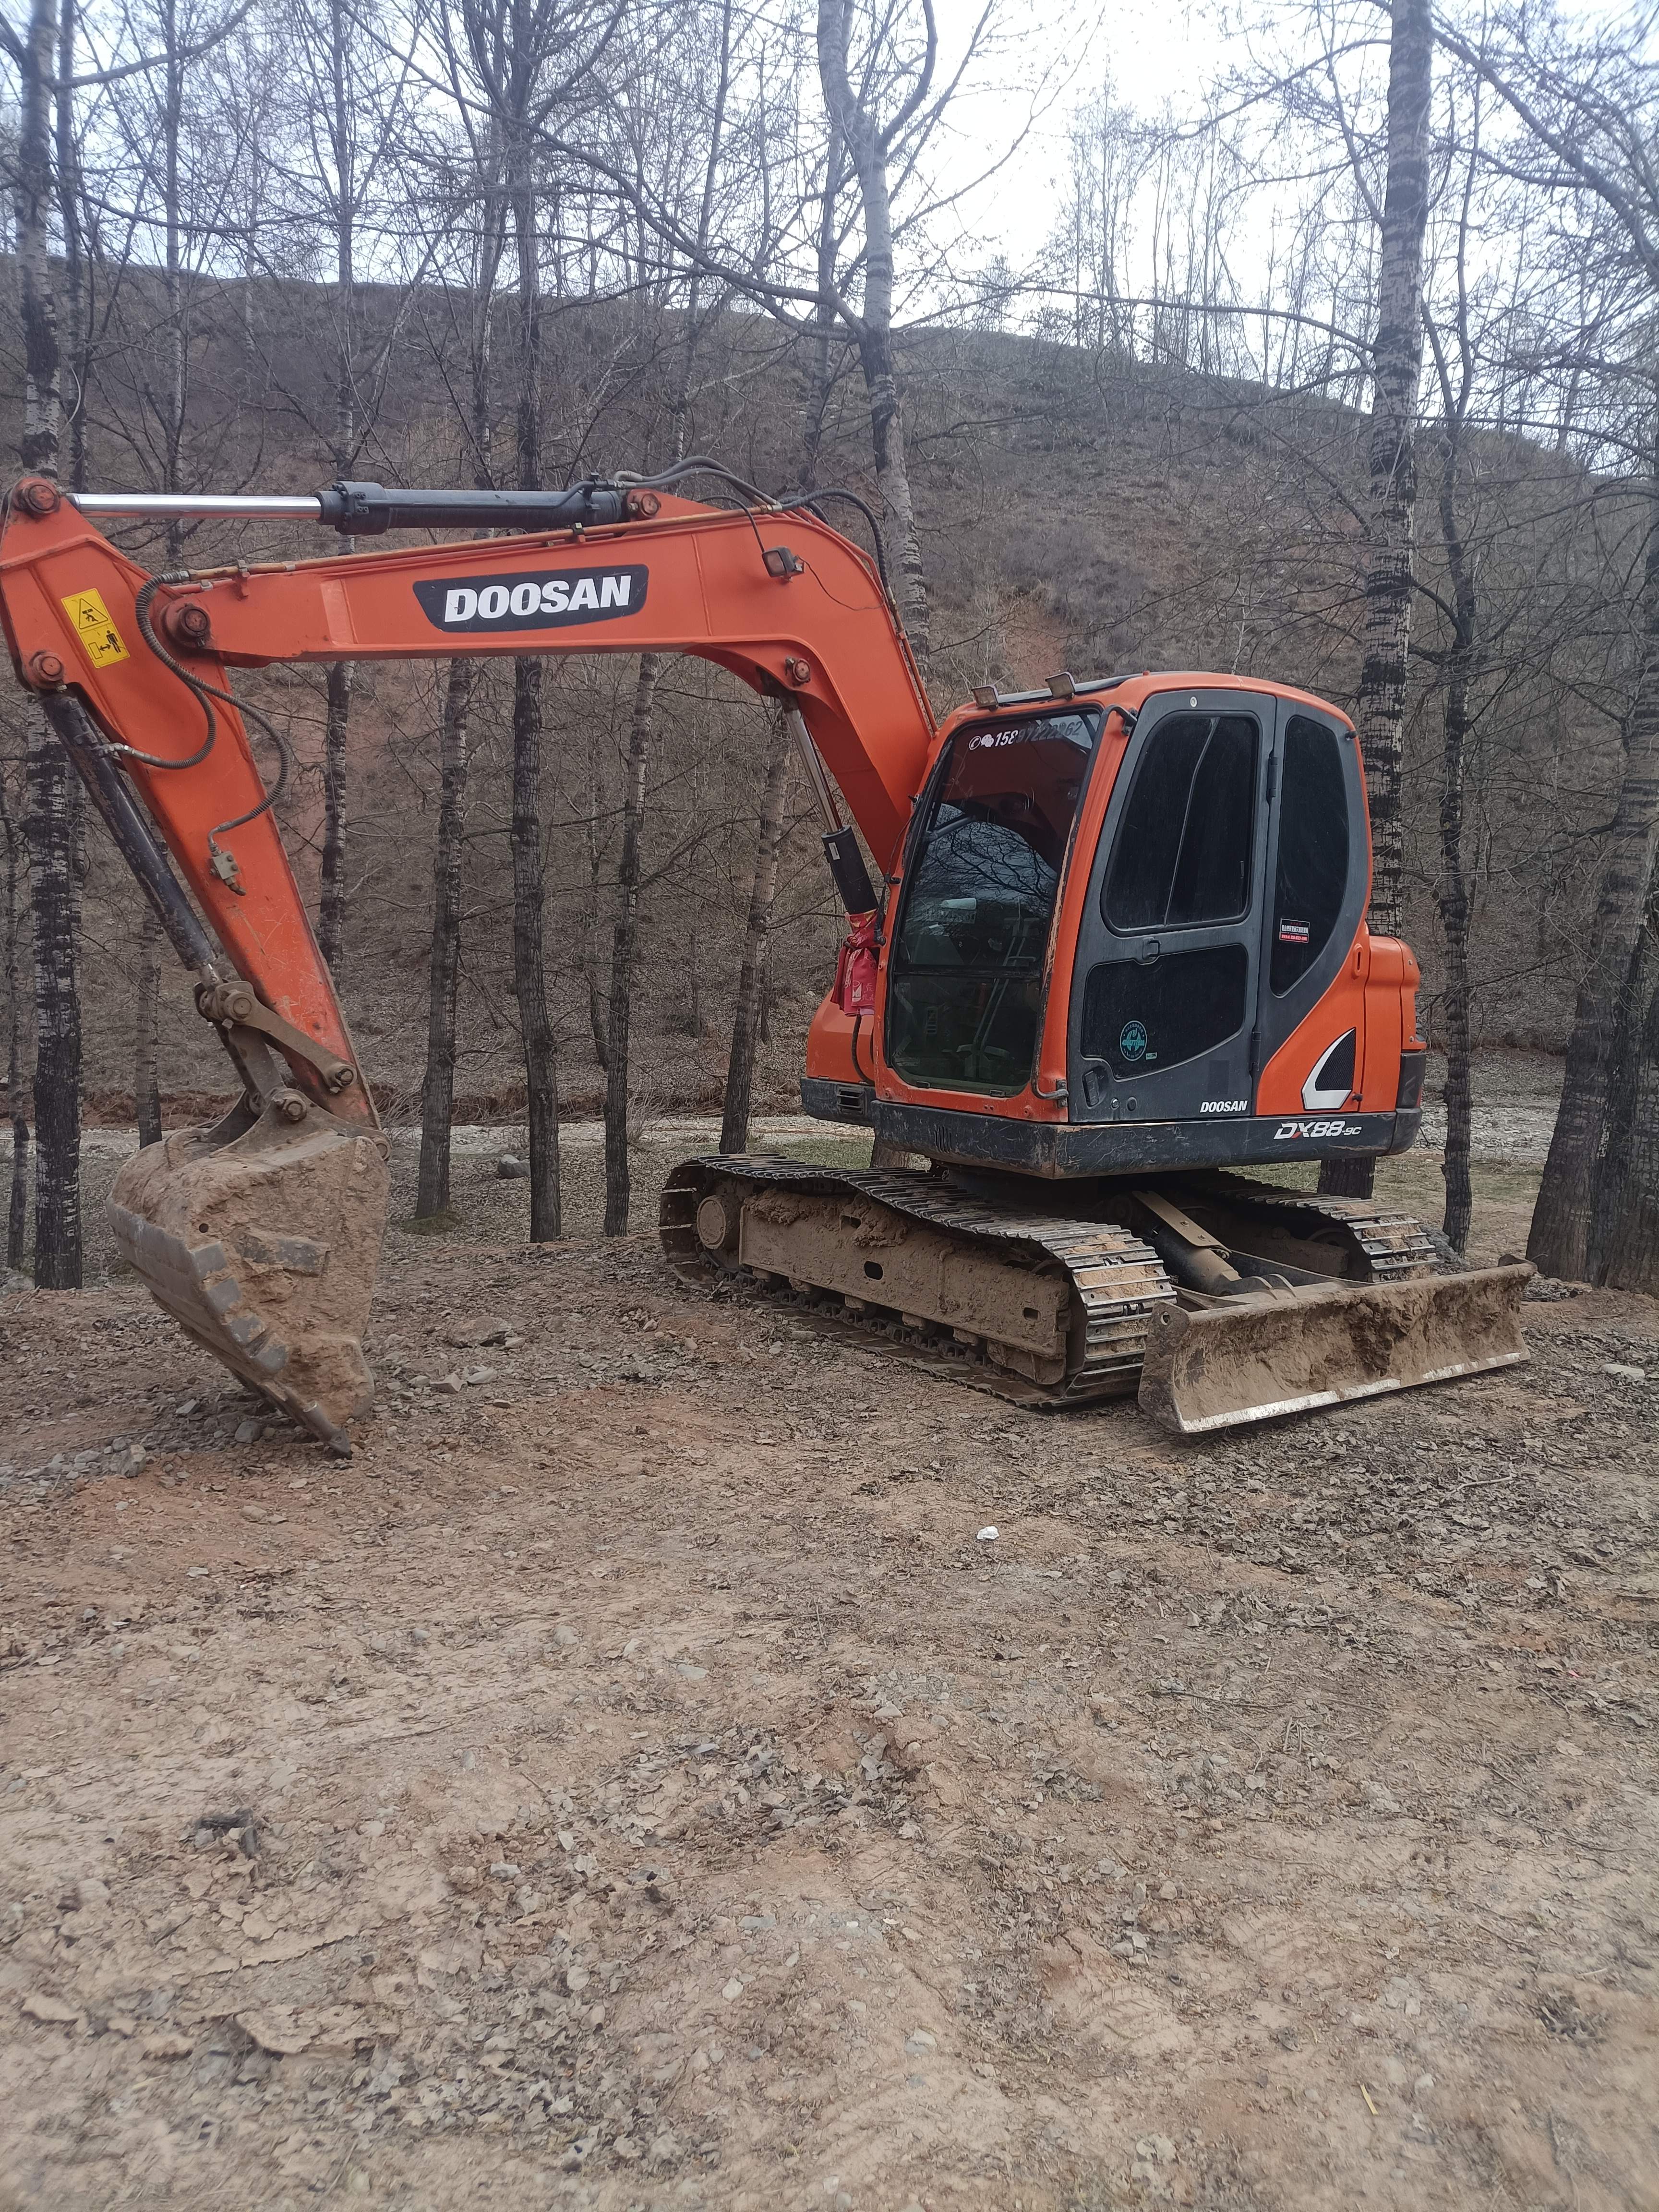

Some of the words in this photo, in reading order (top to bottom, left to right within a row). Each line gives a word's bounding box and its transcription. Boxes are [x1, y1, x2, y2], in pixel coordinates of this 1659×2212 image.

[444, 575, 632, 623] DOOSAN
[1200, 1100, 1248, 1113] DOOSAN
[1273, 1121, 1362, 1140] DX88-9C
